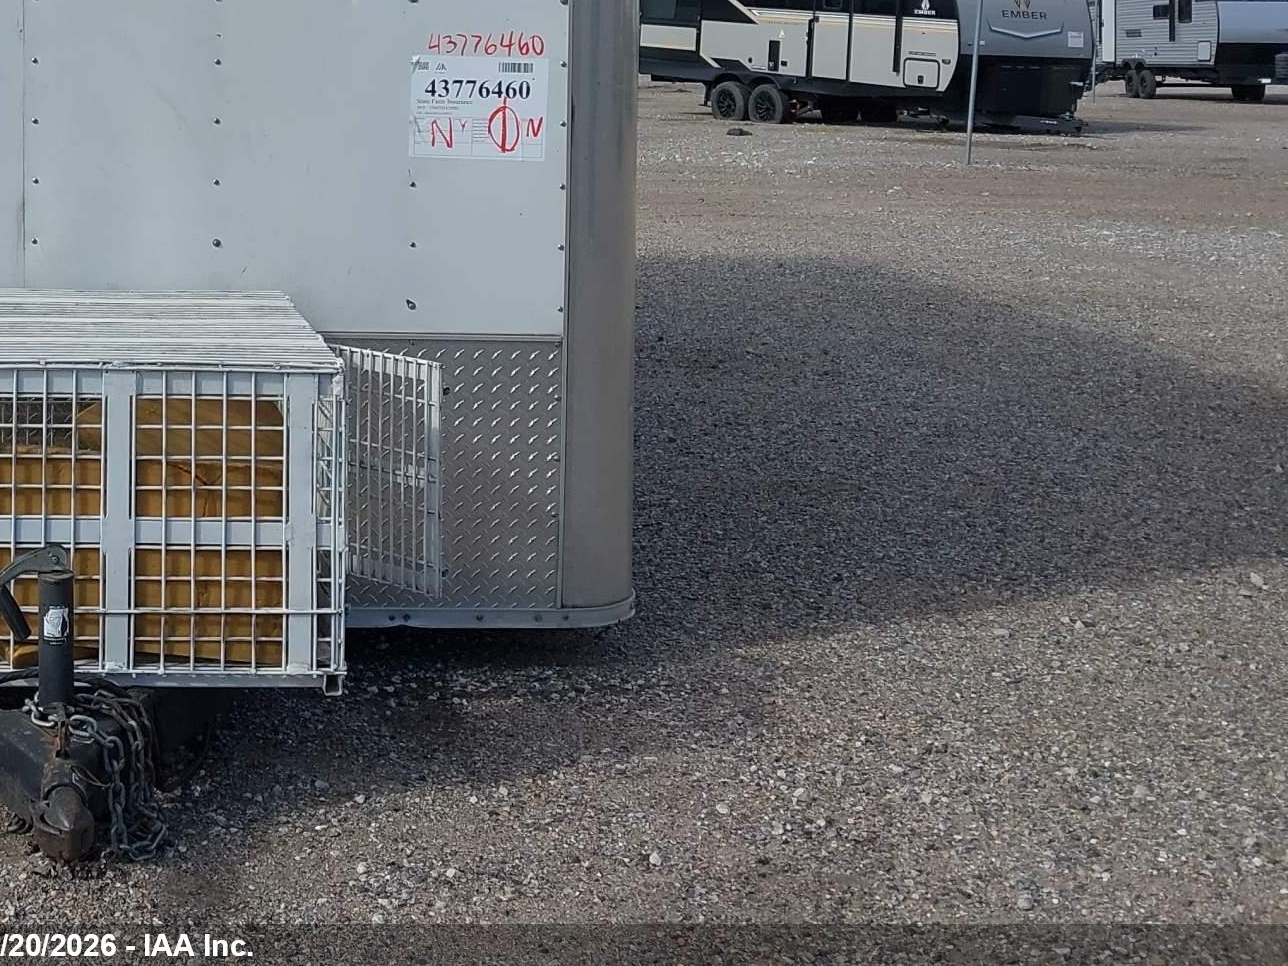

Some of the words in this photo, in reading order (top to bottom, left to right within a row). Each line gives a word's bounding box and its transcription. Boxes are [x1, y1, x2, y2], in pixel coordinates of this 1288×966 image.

[1001, 9, 1048, 20] EMBER
[428, 31, 545, 56] 43776460
[424, 78, 531, 99] 43776460
